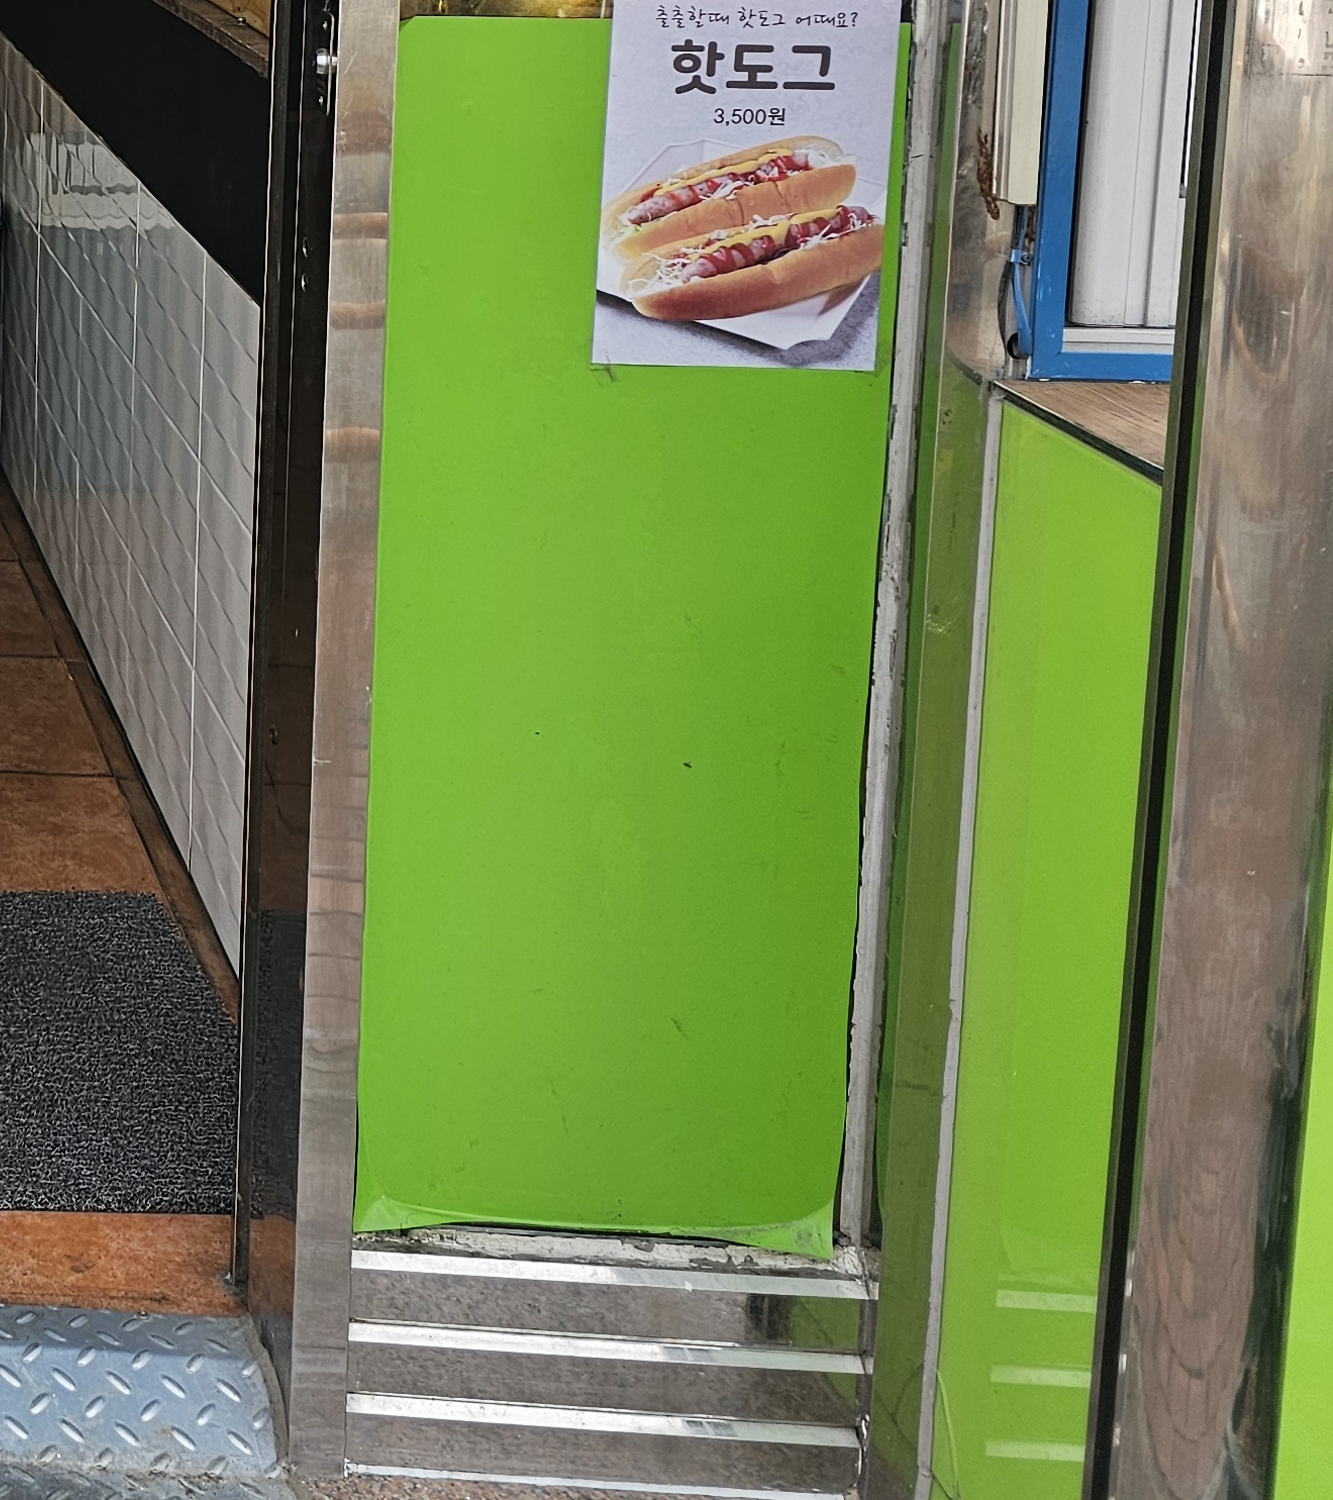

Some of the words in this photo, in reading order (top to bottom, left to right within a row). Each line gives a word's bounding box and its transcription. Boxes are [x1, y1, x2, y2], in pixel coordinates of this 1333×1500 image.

[655, 4, 731, 30] 출출할때
[736, 5, 787, 30] 핫도그
[794, 10, 860, 29] 어때요?
[671, 38, 836, 96] 핫도그
[713, 107, 787, 127] 3,500원
